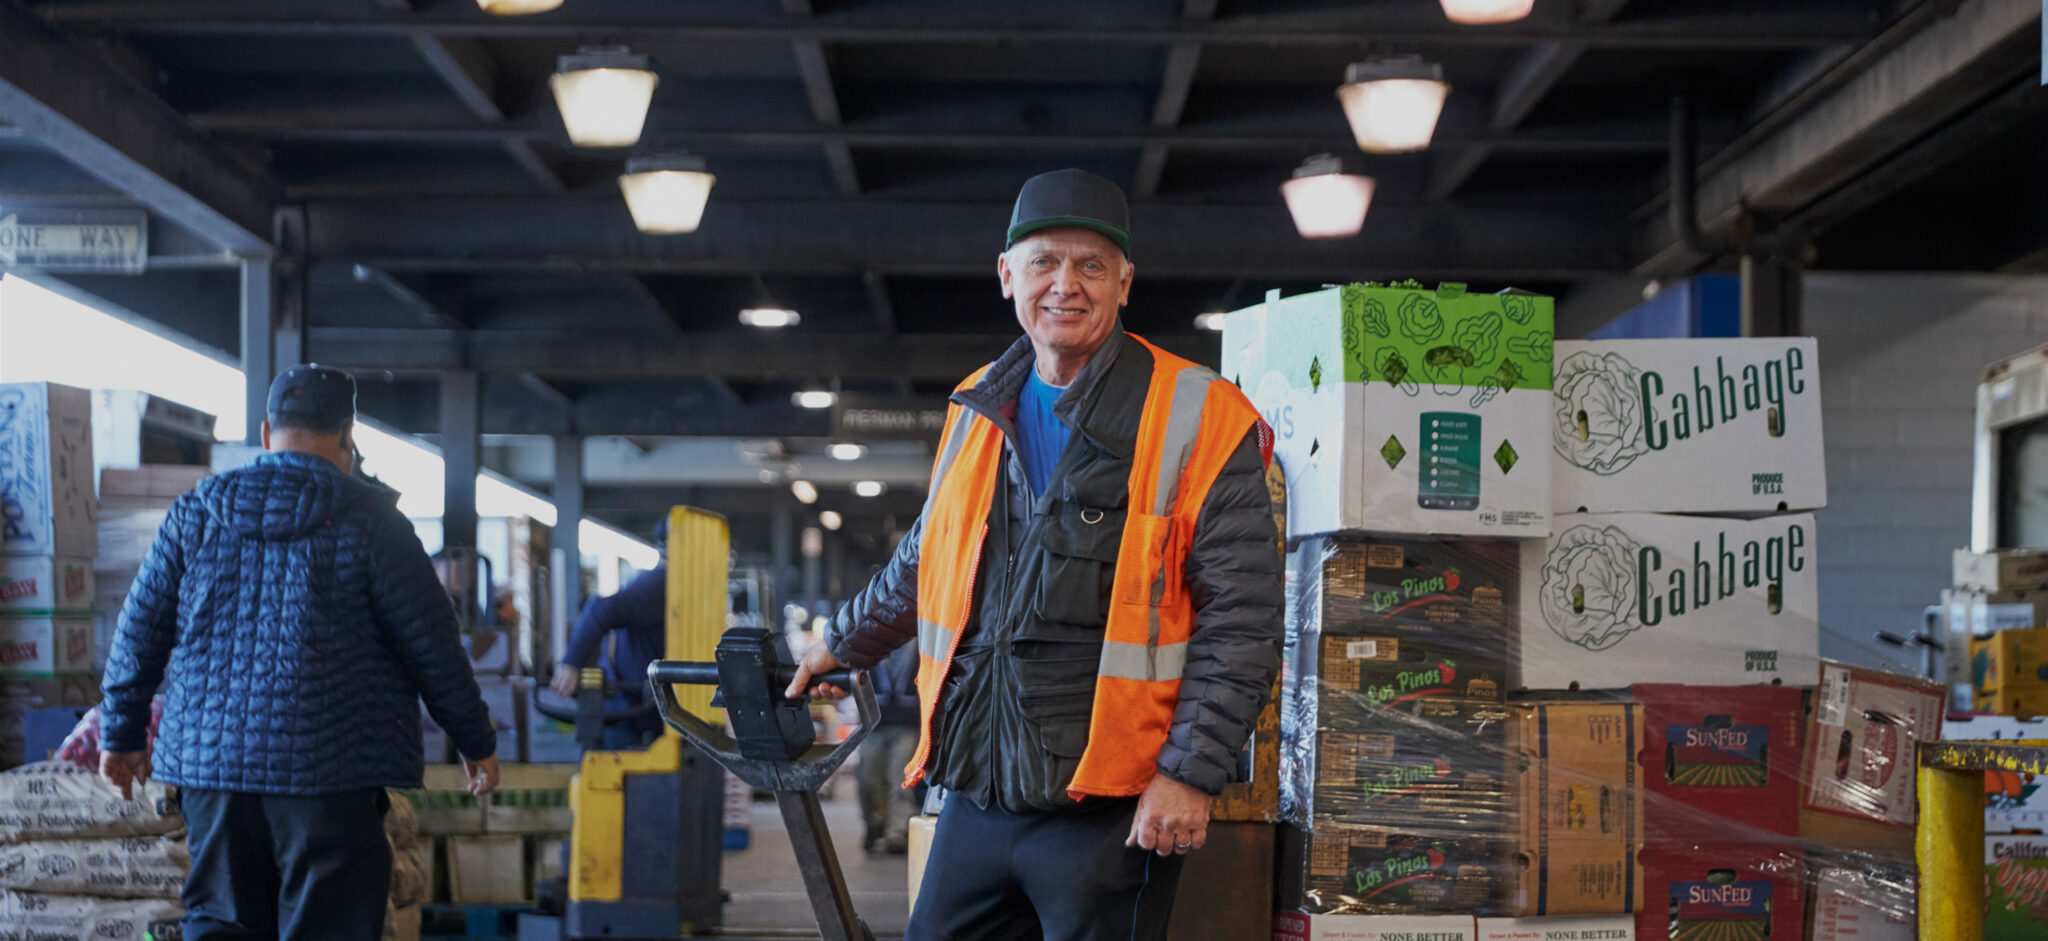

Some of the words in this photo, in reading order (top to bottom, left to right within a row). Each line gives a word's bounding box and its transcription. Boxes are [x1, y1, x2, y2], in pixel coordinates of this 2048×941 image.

[0, 226, 47, 247] ONE
[80, 226, 129, 247] WAY
[1640, 347, 1805, 451] Cabbage
[1752, 473, 1784, 484] PRODUCE
[1752, 484, 1762, 494] OF
[1763, 483, 1784, 495] U.S.A.
[1479, 512, 1497, 522] FMS
[1639, 524, 1805, 626] Cabbage
[1372, 590, 1399, 612] Los
[1400, 576, 1445, 598] Pinos
[1745, 650, 1777, 661] PRODUCE
[1745, 661, 1755, 671] OF
[1368, 684, 1395, 705] Los
[1396, 668, 1440, 691] Pinos
[1363, 780, 1389, 802] Los
[1391, 765, 1435, 786] Pinos
[1355, 871, 1383, 893] Los
[1384, 855, 1429, 878] Pinos
[1380, 932, 1413, 941] NONE
[1416, 932, 1464, 941] BETTER
[1546, 930, 1578, 940] NONE
[1581, 929, 1627, 940] BETTER
